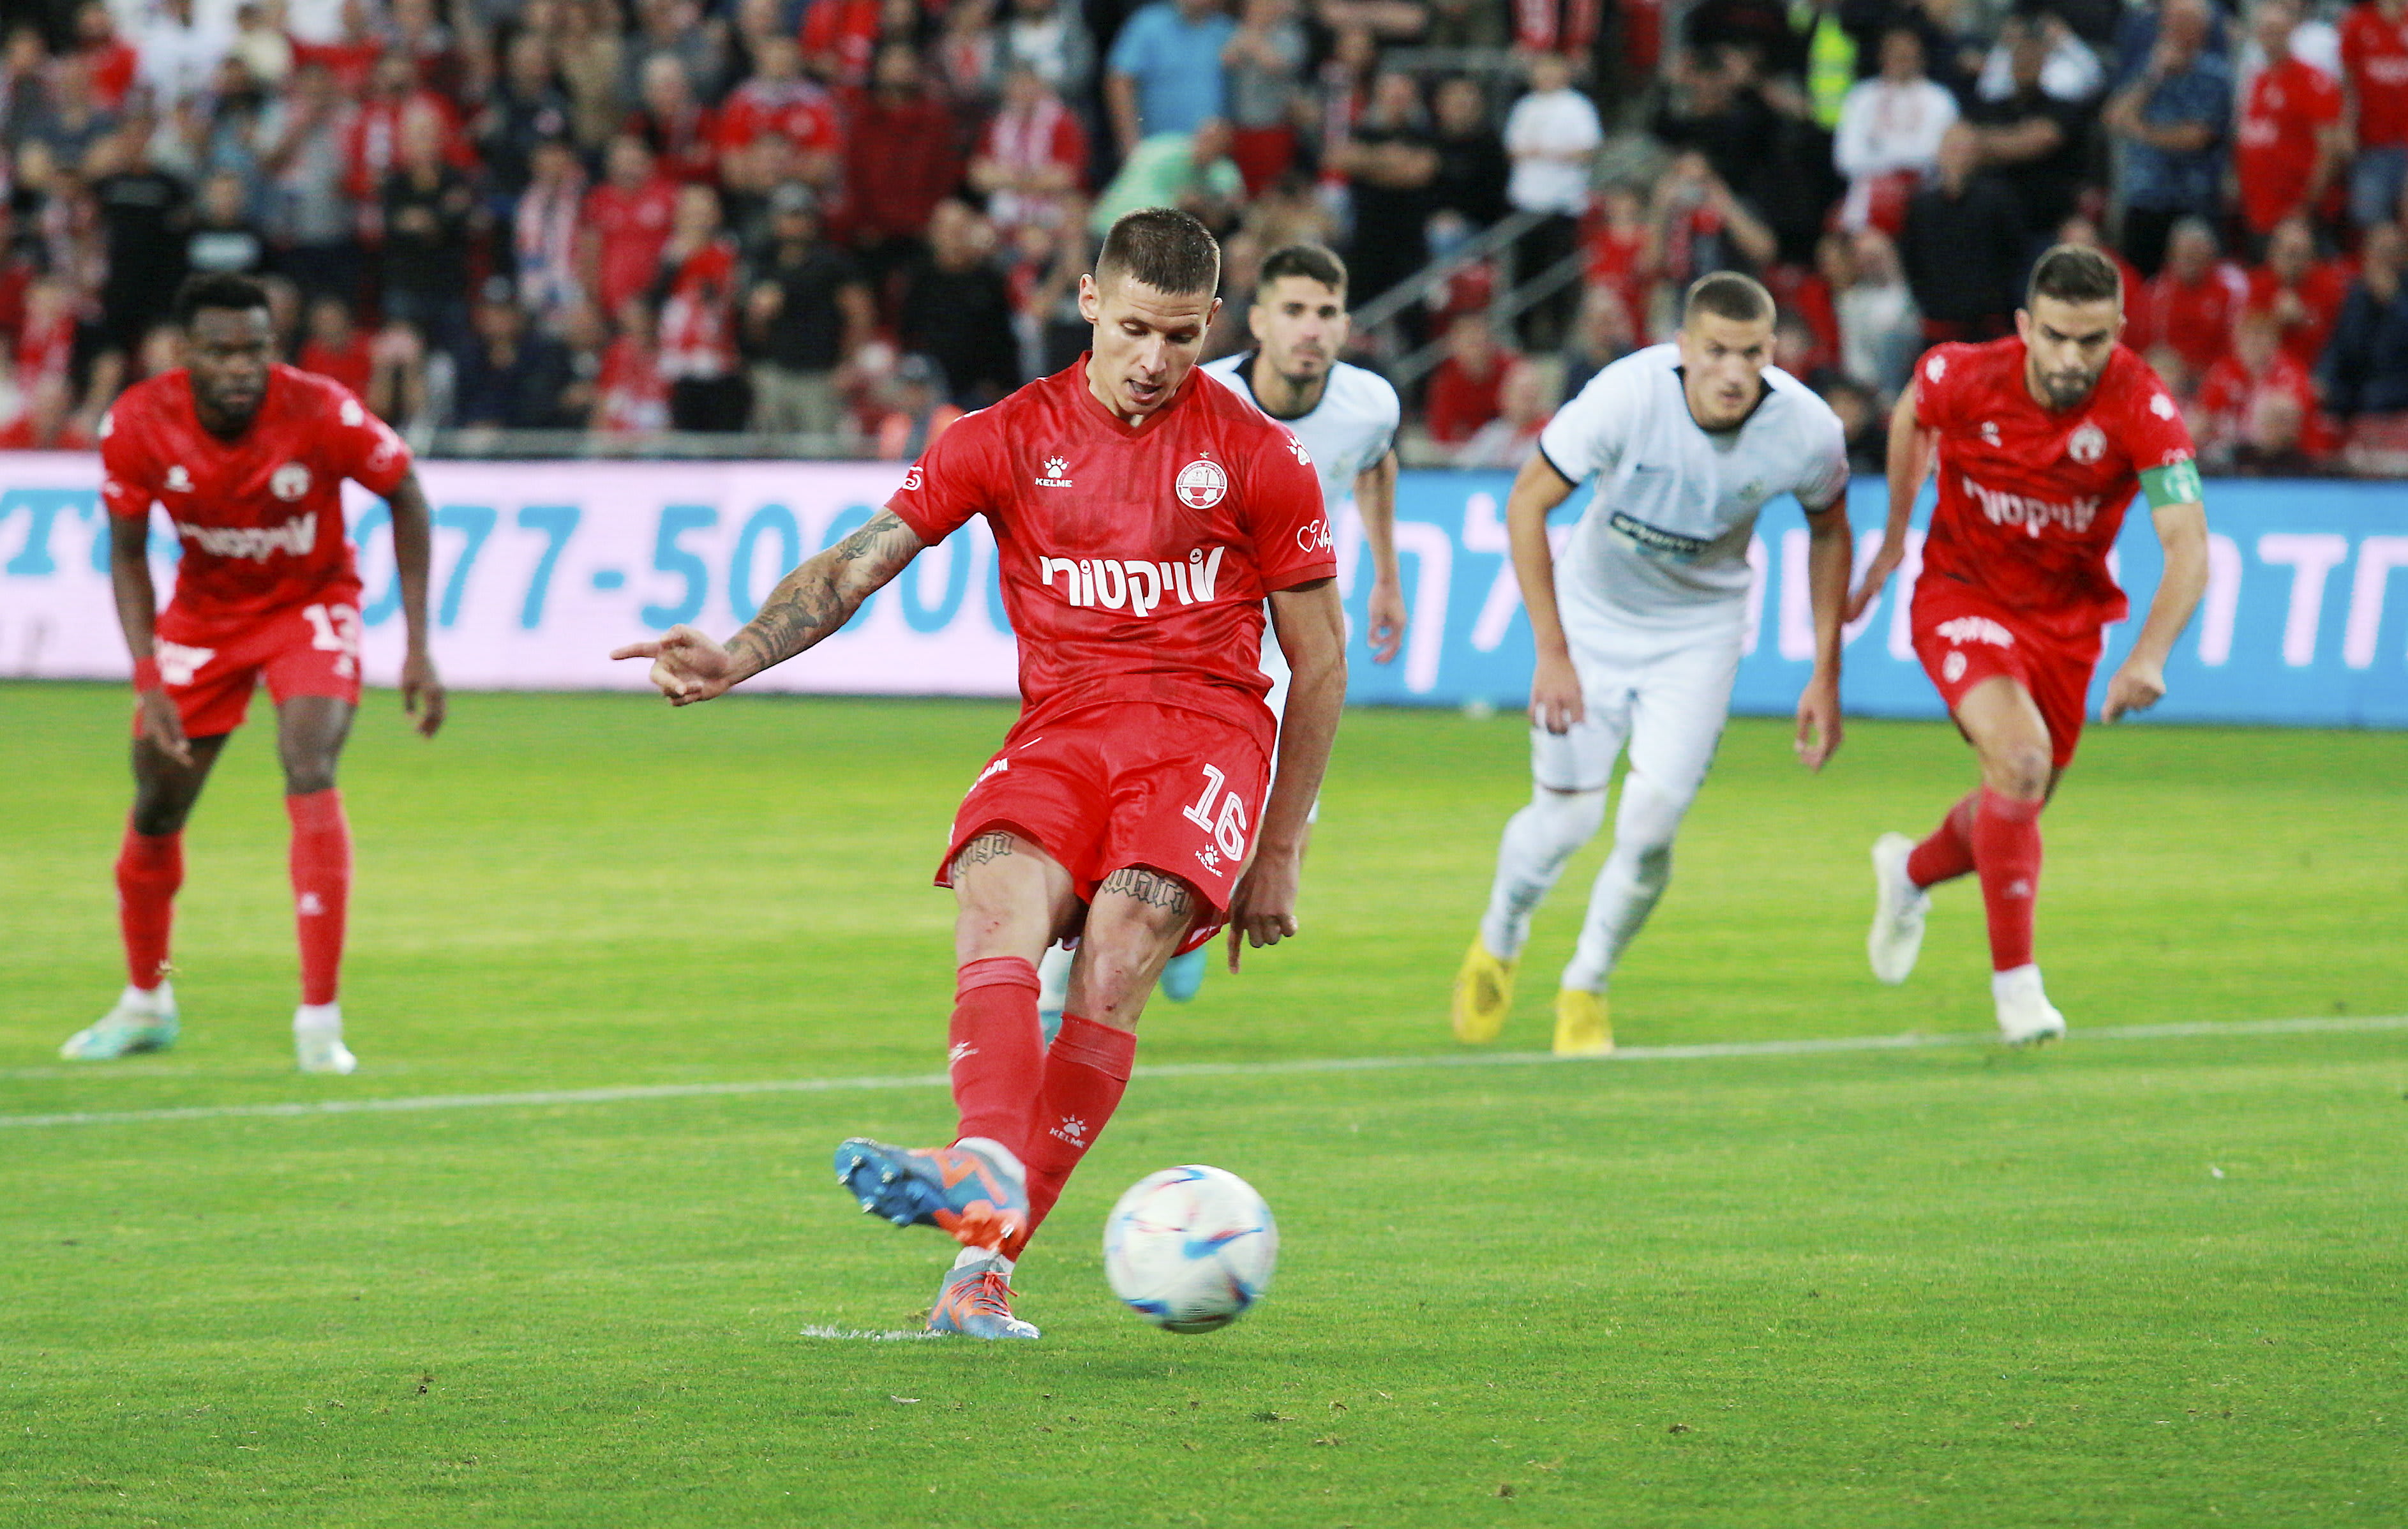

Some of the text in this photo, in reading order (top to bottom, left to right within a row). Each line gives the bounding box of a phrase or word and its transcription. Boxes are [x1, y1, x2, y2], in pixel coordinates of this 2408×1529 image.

[1035, 477, 1073, 488] KELME
[1182, 762, 1248, 861] 16
[1194, 850, 1223, 878] KELME
[1049, 1127, 1086, 1149] KELME
